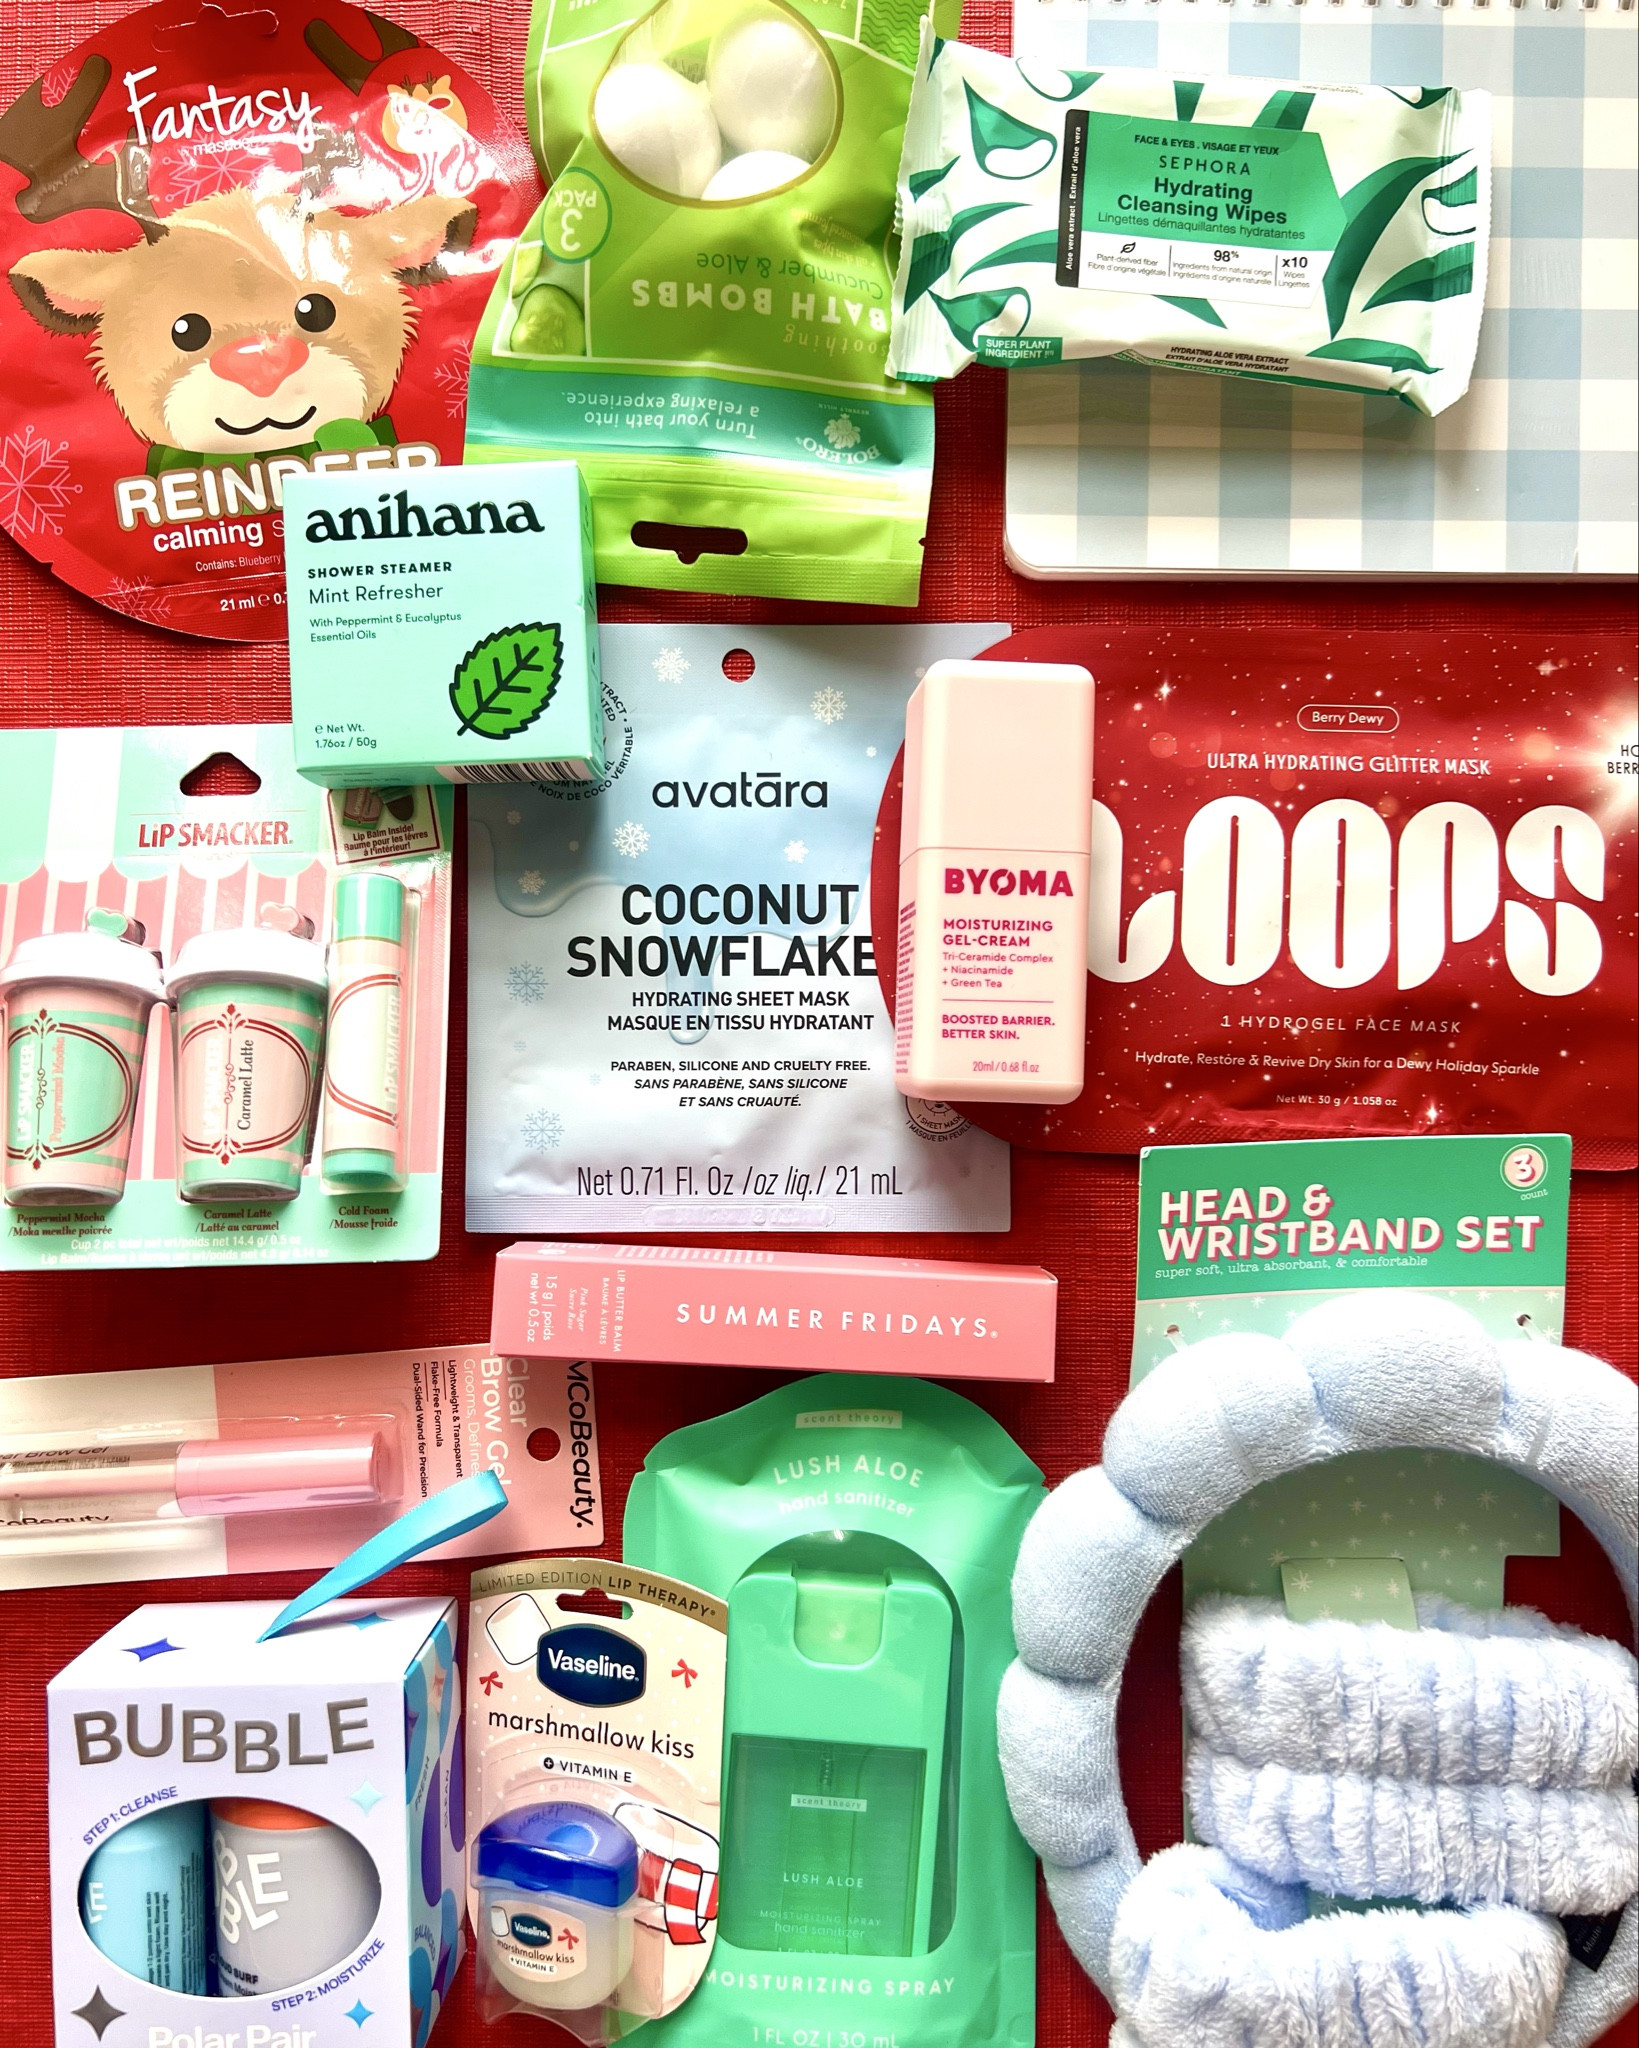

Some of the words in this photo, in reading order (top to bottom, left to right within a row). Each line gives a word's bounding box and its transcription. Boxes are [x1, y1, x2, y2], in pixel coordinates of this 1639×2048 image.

[123, 66, 323, 154] Fantasy
[1134, 134, 1160, 146] FACE
[1161, 136, 1169, 146] &
[1170, 137, 1195, 149] EYES
[1202, 141, 1237, 153] VISAGE
[1238, 144, 1251, 154] ET
[1253, 145, 1280, 156] YEUX
[1158, 155, 1251, 176] SEPHORA
[552, 189, 597, 208] PACK
[1153, 176, 1253, 204] Hydrating
[1117, 194, 1219, 221] Cleansing
[1225, 203, 1288, 225] Wipes
[560, 208, 583, 252] 3
[1098, 211, 1150, 227] Lingettes
[1152, 216, 1237, 235] démaquillantes
[1239, 225, 1306, 240] hydratantes
[1213, 249, 1240, 263] 98%
[1281, 256, 1308, 268] x10
[632, 278, 773, 316] BOMBS
[791, 290, 888, 334] BATH
[985, 348, 1042, 359] INGREDIENT
[986, 339, 1015, 349] SUPER
[1016, 339, 1051, 350] PLANT
[1170, 346, 1211, 359] HYDRATING
[1213, 350, 1232, 361] ALOE
[1233, 352, 1254, 362] VERA
[1254, 354, 1290, 365] EXTRACT
[584, 411, 620, 428] into
[624, 412, 665, 429] bath
[668, 413, 709, 430] your
[715, 418, 757, 439] Turn
[801, 435, 881, 465] BOLERO
[305, 489, 545, 543] anihana
[153, 521, 264, 552] calming
[195, 558, 237, 572] Contains:
[238, 552, 282, 567] Blueberry
[307, 565, 375, 579] SHOWER
[380, 561, 453, 576] STEAMER
[309, 587, 349, 605] Mint
[355, 583, 444, 602] Refresher
[310, 631, 355, 643] Essential
[355, 629, 377, 641] Oils
[326, 723, 345, 735] Net
[346, 722, 366, 734] Wt.
[1311, 711, 1346, 726] Berry
[1348, 711, 1385, 727] Dewy
[1206, 752, 1259, 770] ULTRA
[1263, 753, 1364, 773] HYDRATING
[1368, 755, 1440, 774] GLITTER
[1444, 757, 1491, 776] MASK
[352, 832, 366, 842] Lip
[366, 829, 387, 839] Balm
[944, 867, 1074, 897] BYOMA
[621, 884, 860, 925] COCONUT
[1086, 795, 1605, 997] LOOPS
[943, 918, 1054, 933] MOISTURIZING
[942, 934, 1031, 948] GEL-CREAM
[566, 935, 878, 977] SNOWFLAKE
[942, 951, 1007, 963] Tri-Ceramide
[1008, 952, 1054, 965] Complex
[632, 991, 733, 1007] HYDRATING
[736, 991, 794, 1007] SHEET
[799, 991, 850, 1007] MASK
[607, 1015, 682, 1031] MASQUE
[686, 1015, 710, 1030] EN
[714, 1014, 765, 1030] TISSU
[770, 1014, 875, 1030] HYDRATANT
[941, 1014, 999, 1026] BOOSTED
[1001, 1015, 1056, 1027] BARRIER.
[1219, 1015, 1232, 1029] 1
[1239, 1015, 1347, 1032] HYDROGEL
[1354, 1017, 1402, 1033] FACE
[1409, 1019, 1462, 1034] MASK
[941, 1028, 986, 1040] BETTER
[988, 1029, 1021, 1040] SKIN.
[239, 1039, 254, 1074] Latte
[610, 1060, 676, 1073] PARABEN,
[678, 1060, 739, 1071] SILICONE
[742, 1060, 770, 1071] AND
[774, 1060, 832, 1071] CRUELTY
[835, 1060, 871, 1071] FREE.
[634, 1078, 670, 1089] SANS
[672, 1076, 745, 1091] PARABÈNE,
[748, 1078, 785, 1089] SANS
[786, 1078, 848, 1089] SILICONE
[236, 1075, 253, 1131] Caramel
[678, 1096, 696, 1107] ET
[698, 1096, 734, 1107] SANS
[737, 1093, 802, 1107] CRUAUTÉ.
[1513, 1154, 1536, 1182] 3
[1160, 1186, 1290, 1226] HEAD
[1302, 1183, 1333, 1219] &
[1520, 1188, 1548, 1201] count
[16, 1213, 72, 1225] Peppermint
[73, 1211, 106, 1223] Mocha
[203, 1208, 245, 1220] Caramel
[246, 1208, 272, 1219] Latte
[338, 1205, 361, 1217] Cold
[363, 1205, 389, 1216] Foam
[1157, 1216, 1443, 1263] WRISTBAND
[1455, 1214, 1543, 1252] SET
[530, 1272, 540, 1289] net
[616, 1269, 627, 1283] LIP
[529, 1291, 539, 1305] wt
[614, 1286, 626, 1321] BUTTER
[527, 1308, 540, 1327] 0.5
[676, 1303, 824, 1330] SUMMER
[527, 1328, 536, 1343] oz
[612, 1325, 624, 1352] BALM
[412, 1362, 424, 1412] Dual-Sided
[430, 1361, 441, 1408] Flake-Free
[447, 1359, 460, 1414] Lightweight
[505, 1356, 529, 1428] Clear
[416, 1413, 426, 1441] Wand
[453, 1415, 460, 1423] &
[803, 1413, 842, 1424] scent
[848, 1411, 895, 1425] theory
[434, 1410, 444, 1448] Formula
[418, 1442, 427, 1454] for
[452, 1423, 464, 1478] Transparent
[419, 1456, 430, 1498] Precision
[773, 1454, 841, 1485] LUSH
[853, 1454, 924, 1489] ALOE
[778, 1490, 828, 1515] hand
[833, 1490, 915, 1519] sanitizer
[73, 1697, 375, 1774] BUBBLE
[488, 1711, 645, 1751] marshmallow
[651, 1729, 695, 1759] kiss
[559, 1760, 619, 1781] VITAMIN
[623, 1771, 633, 1783] E
[83, 1815, 111, 1845] STEP
[119, 1785, 178, 1817] CLEANSE
[782, 1872, 820, 1885] LUSH
[826, 1875, 865, 1888] ALOE
[774, 1921, 808, 1934] hand
[811, 1924, 866, 1939] sanitizer
[497, 1939, 554, 1962] marshmallow
[555, 1952, 575, 1964] kiss
[271, 1995, 305, 2012] STEP
[317, 1938, 386, 1997] MOISTURIZE
[515, 1958, 547, 1972] VITAMIN
[549, 1965, 555, 1973] E
[705, 1968, 873, 1995] MOISTURIZING
[884, 1977, 955, 1997] SPRAY
